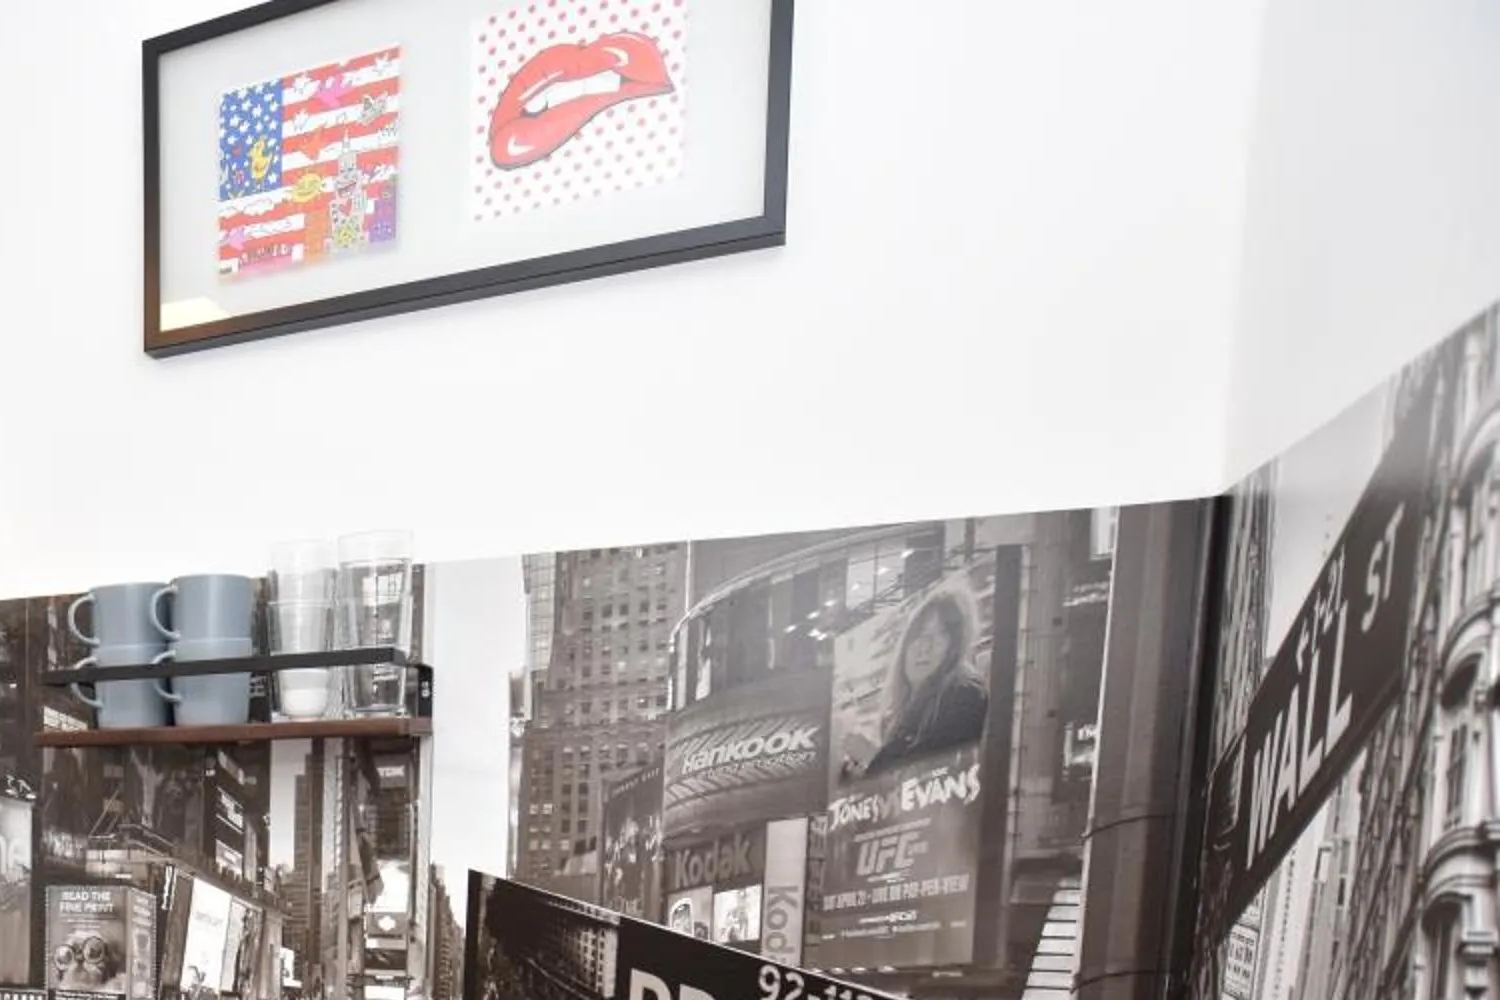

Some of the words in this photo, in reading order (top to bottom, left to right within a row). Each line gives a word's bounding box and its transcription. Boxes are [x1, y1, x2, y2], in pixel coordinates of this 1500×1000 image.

[1246, 600, 1353, 870] WALL
[1361, 501, 1405, 633] ST
[827, 793, 879, 831] JONES
[902, 763, 980, 811] EVANS
[674, 833, 750, 888] Kodak
[856, 832, 921, 876] UFC
